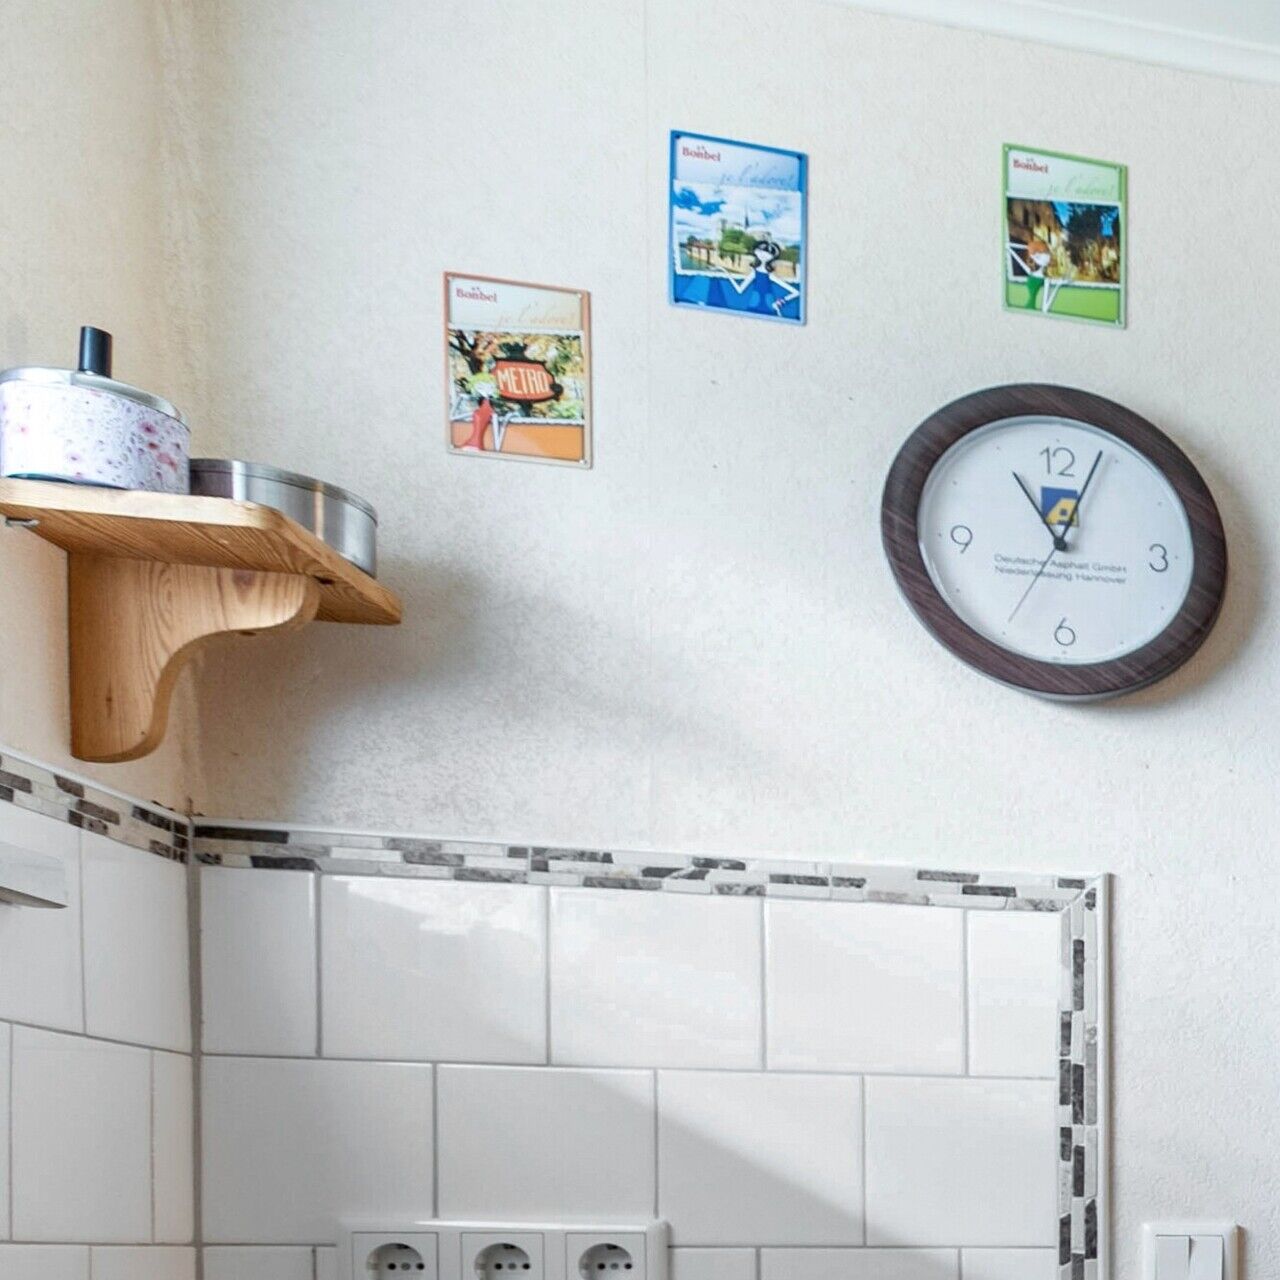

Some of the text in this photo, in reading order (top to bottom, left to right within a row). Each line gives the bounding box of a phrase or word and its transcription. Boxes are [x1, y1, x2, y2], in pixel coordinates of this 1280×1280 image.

[682, 145, 721, 162] Bonbel
[456, 287, 498, 303] Bonbel
[496, 366, 550, 394] METRO
[1039, 447, 1076, 477] 12
[950, 525, 973, 553] 9
[1148, 543, 1169, 573] 3
[1053, 617, 1077, 646] 6
